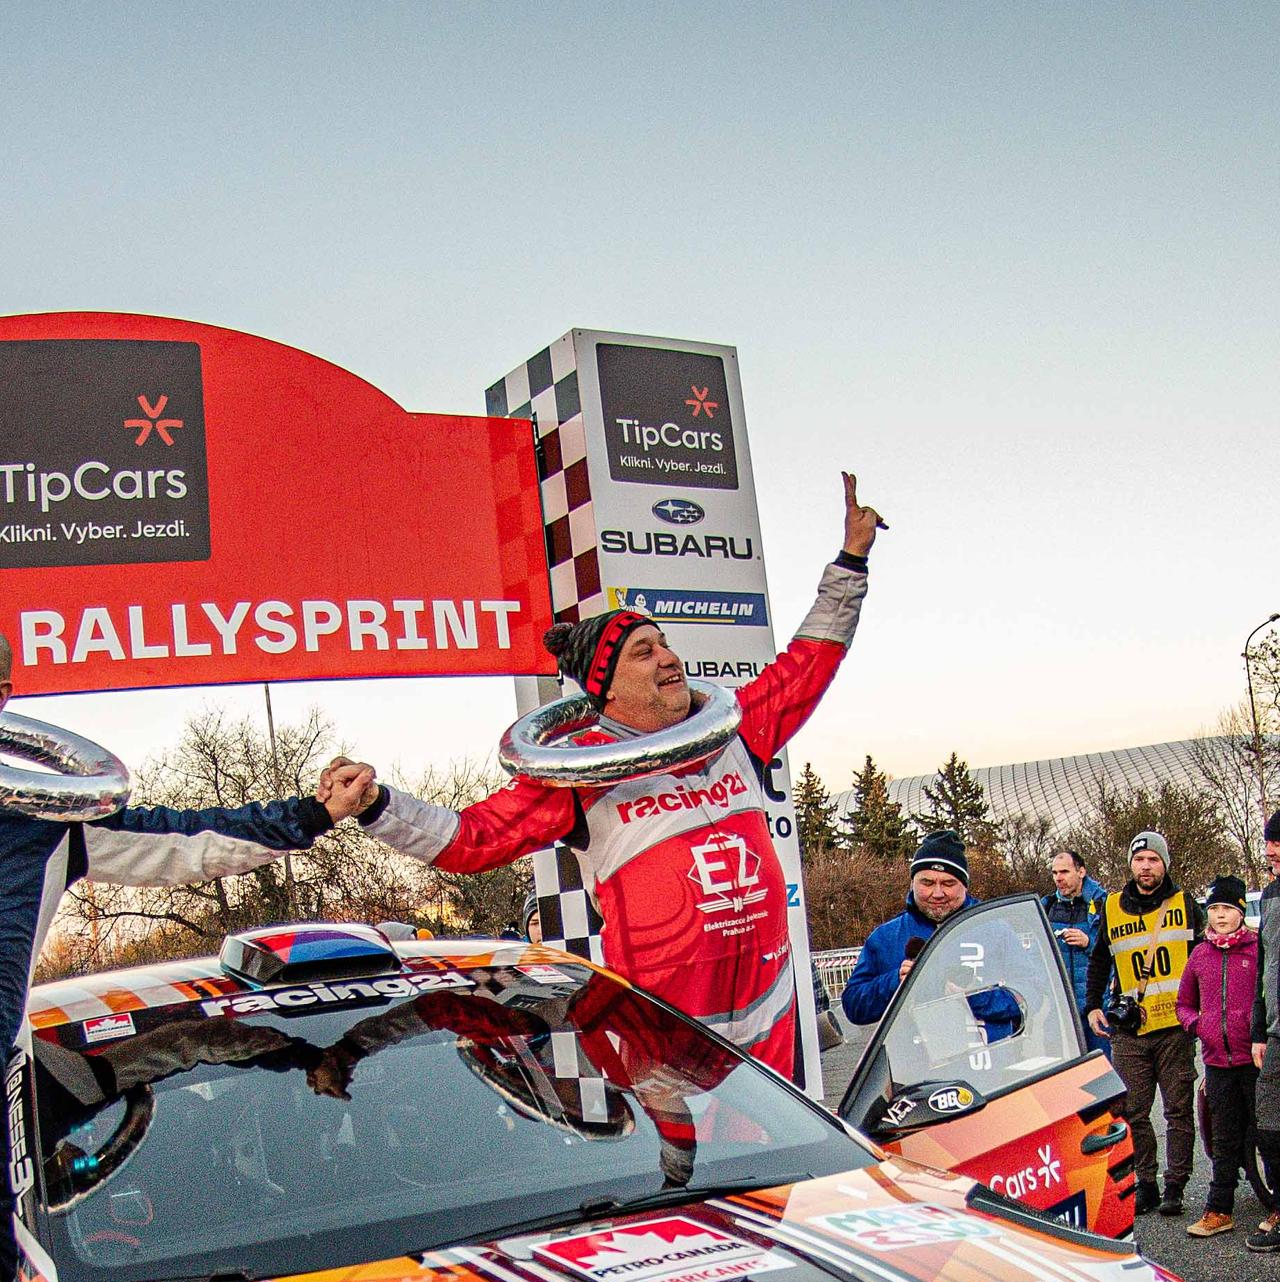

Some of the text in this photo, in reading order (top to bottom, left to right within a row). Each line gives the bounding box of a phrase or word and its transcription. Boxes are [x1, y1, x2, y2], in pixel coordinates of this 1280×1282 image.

[614, 418, 724, 452] TipCars
[620, 454, 728, 475] Klikni. Vyber. Jezdi.
[60, 521, 127, 546] Vyber.
[130, 519, 191, 540] Jezdi.
[601, 529, 754, 560] SUBARU
[653, 599, 754, 617] MICHELIN
[20, 599, 521, 667] RALLYSPRINT
[615, 769, 749, 825] racing21
[1110, 920, 1147, 941] MEDIA
[199, 969, 477, 1018] racing21
